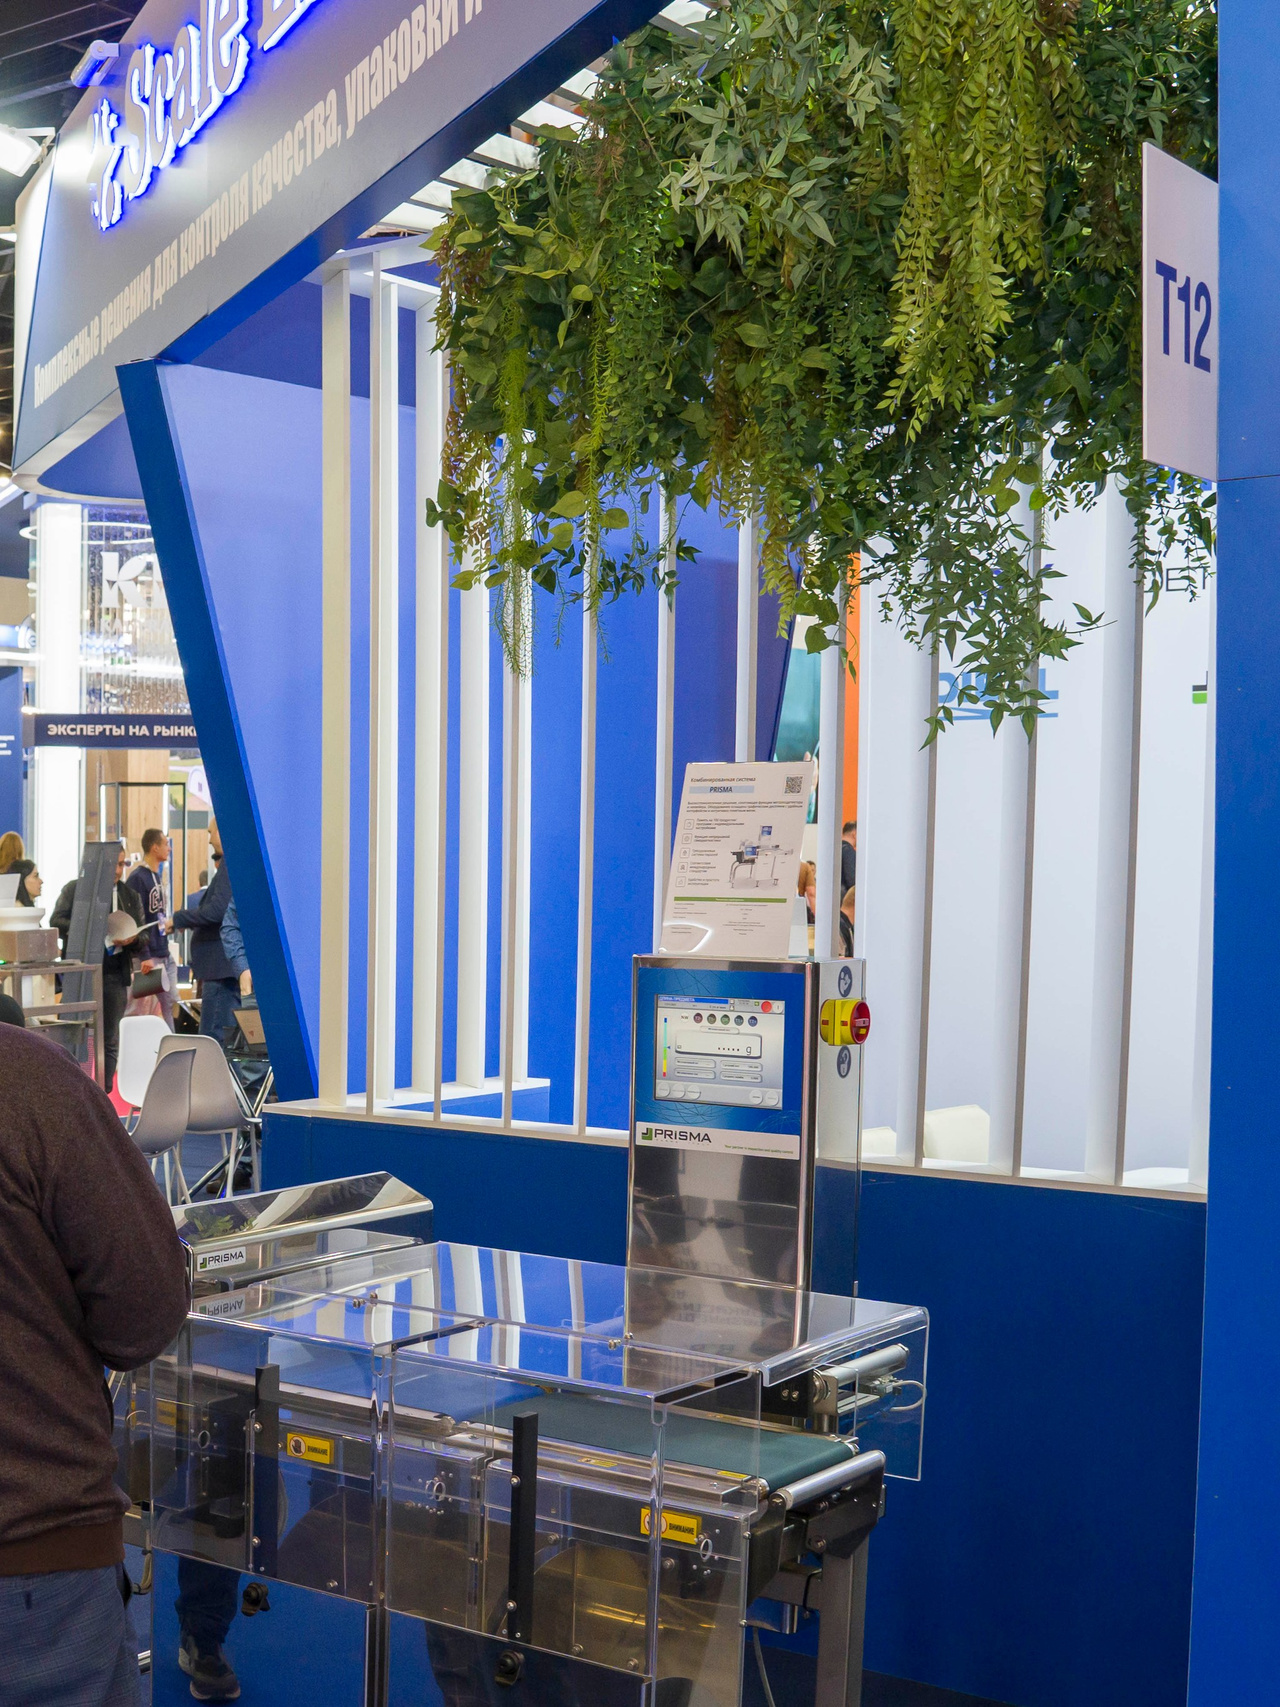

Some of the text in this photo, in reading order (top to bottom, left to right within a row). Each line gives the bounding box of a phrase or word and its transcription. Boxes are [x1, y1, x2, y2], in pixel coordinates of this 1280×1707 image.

[101, 264, 151, 354] решения
[153, 239, 178, 310] для
[180, 171, 249, 278] контроля
[252, 88, 342, 215] качества,
[345, 0, 459, 140] упаковки
[1155, 259, 1212, 373] T12
[47, 724, 197, 737] ЭКСПЕРТЫ НА РЫНК
